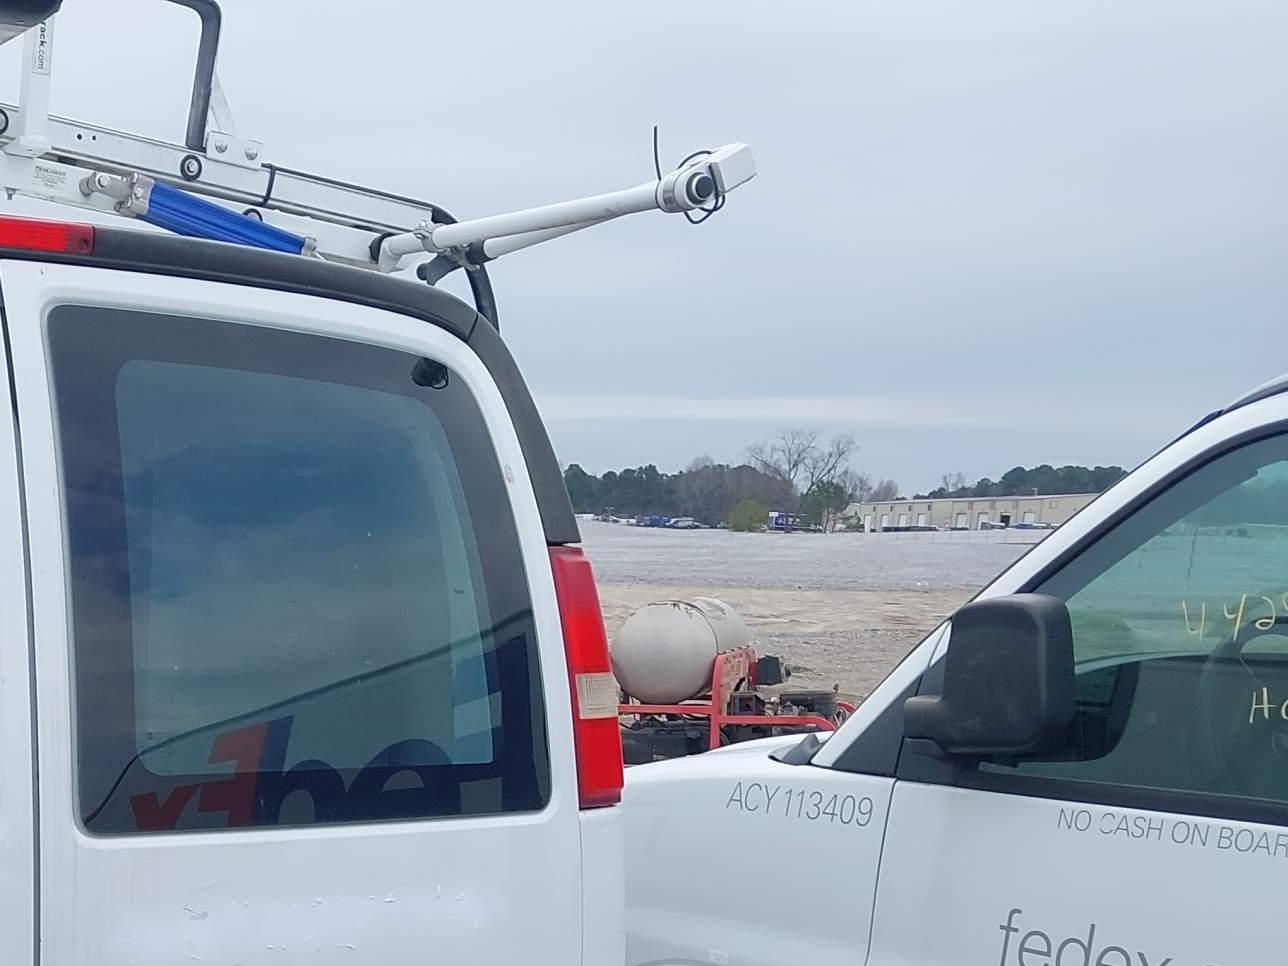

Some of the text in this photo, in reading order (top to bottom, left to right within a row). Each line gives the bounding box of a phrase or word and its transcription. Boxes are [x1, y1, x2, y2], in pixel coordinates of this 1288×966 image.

[1057, 808, 1092, 833] NO
[1099, 813, 1163, 841] CASH
[1171, 821, 1210, 847] ON
